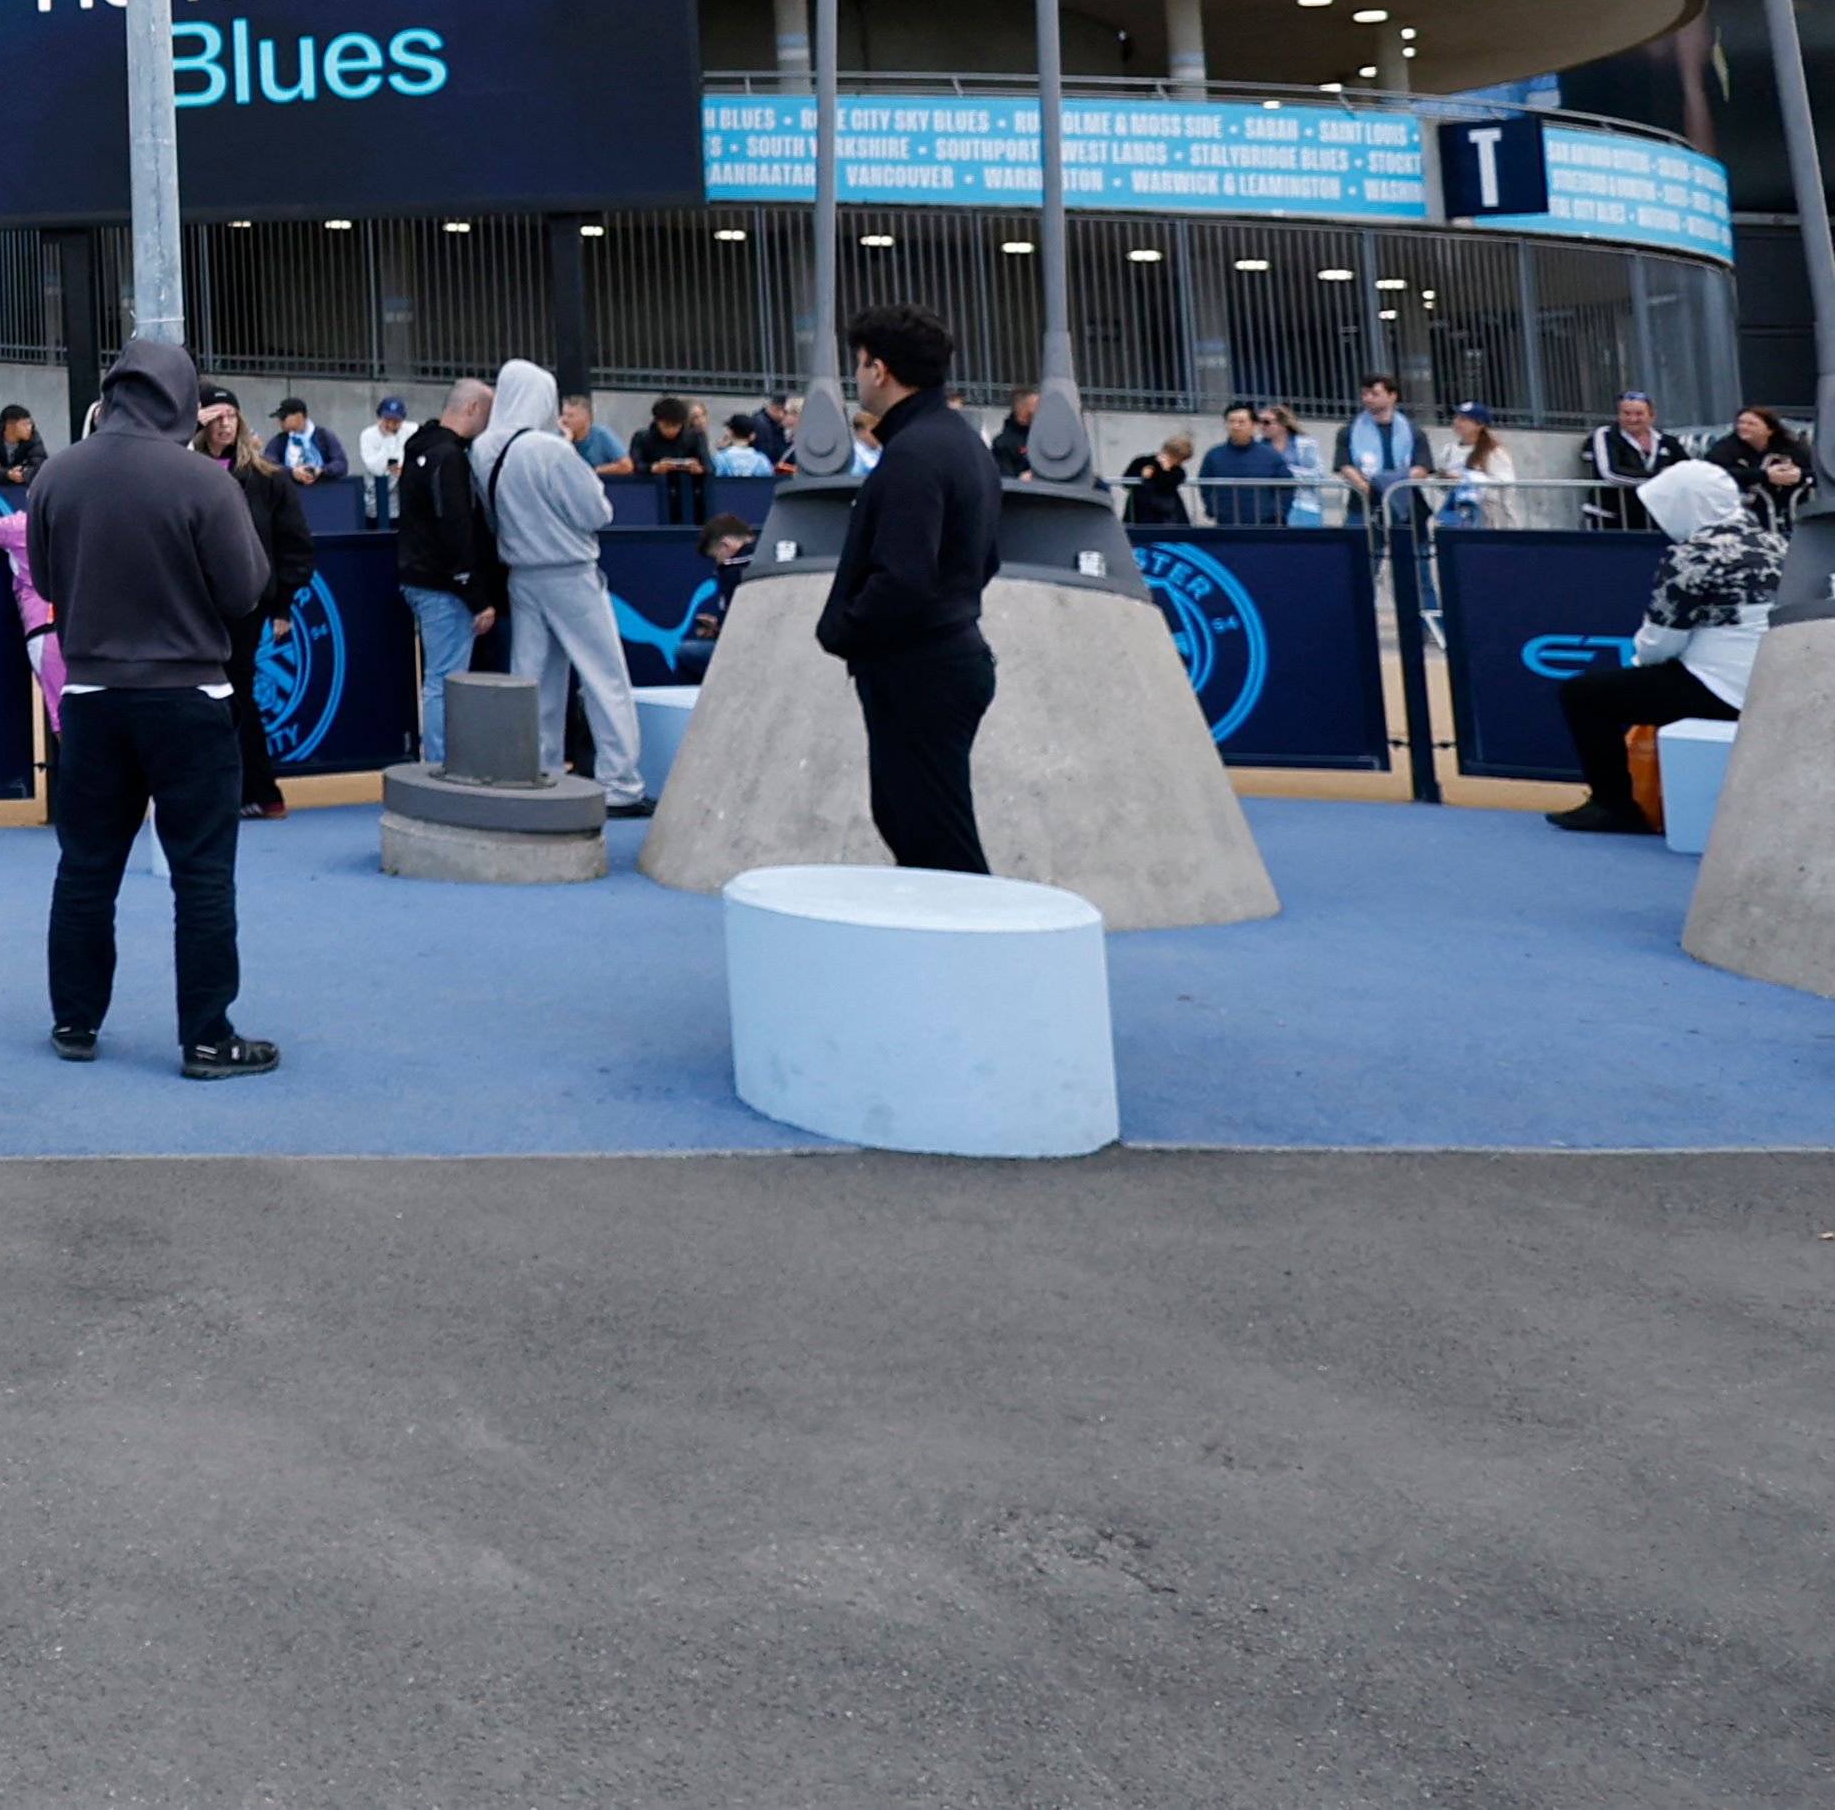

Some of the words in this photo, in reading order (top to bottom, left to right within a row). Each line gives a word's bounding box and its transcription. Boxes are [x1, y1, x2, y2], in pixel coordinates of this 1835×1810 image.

[171, 18, 449, 109] Blues
[851, 109, 890, 132] CITY
[894, 109, 929, 132] SKY
[933, 111, 990, 133] BLUES
[845, 166, 954, 189] VANCOUVER
[1468, 127, 1503, 208] T
